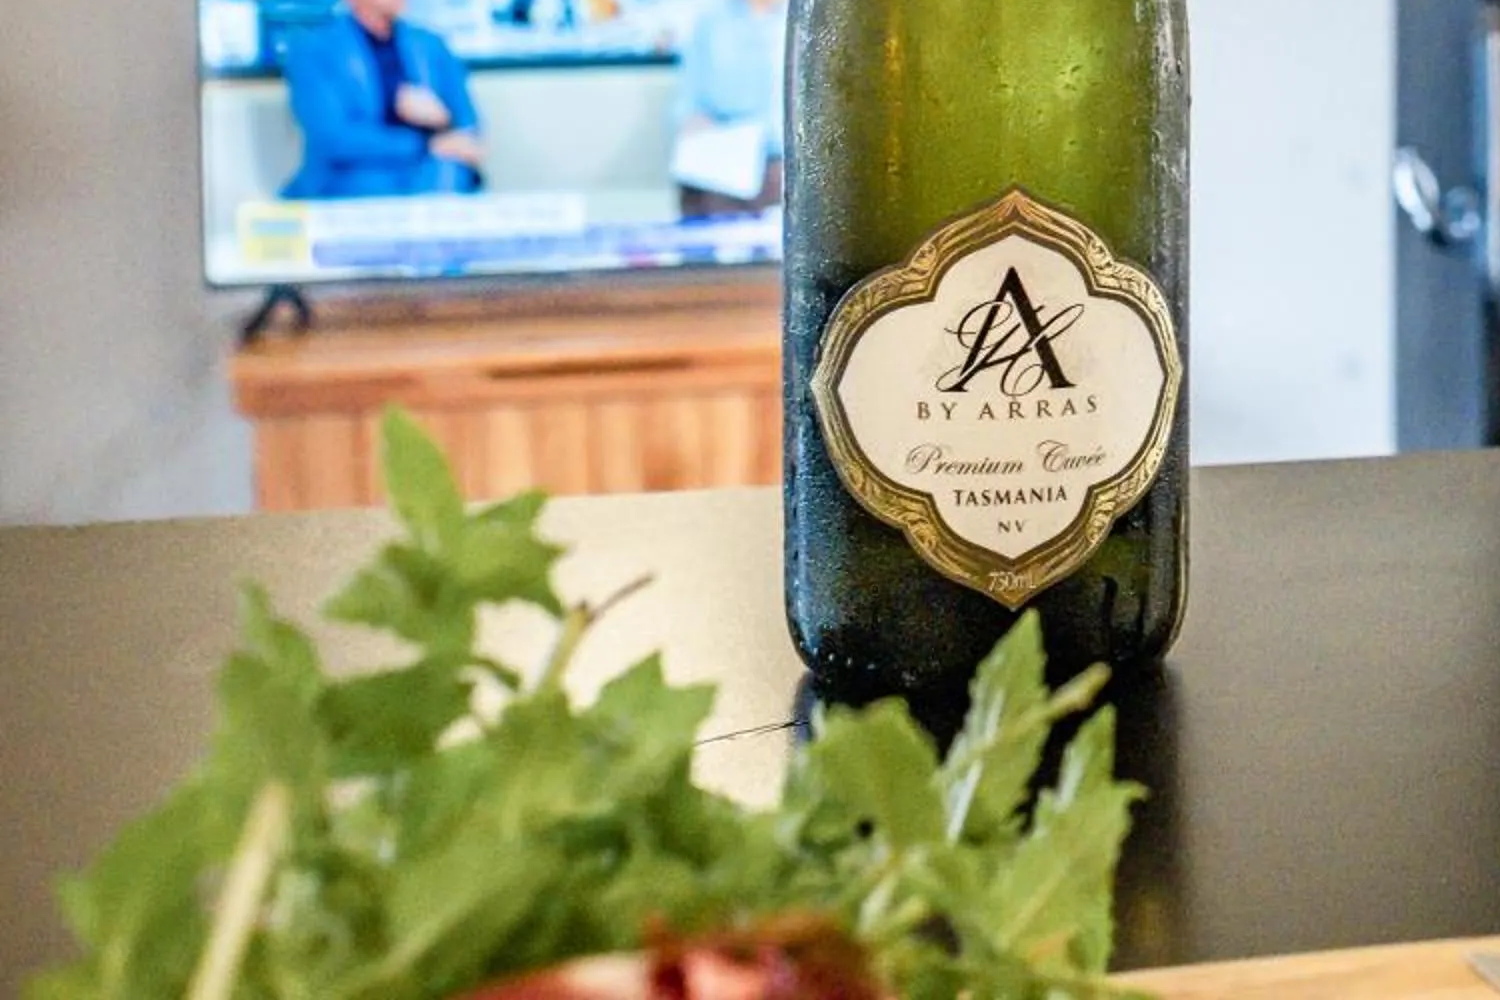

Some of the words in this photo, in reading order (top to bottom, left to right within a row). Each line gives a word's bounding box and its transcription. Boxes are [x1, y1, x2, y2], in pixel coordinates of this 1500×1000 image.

[916, 401, 957, 420] BY
[977, 395, 1097, 420] ARRAS
[905, 442, 1024, 475] Premium
[952, 485, 1068, 507] TASMANIA
[997, 519, 1027, 533] NV
